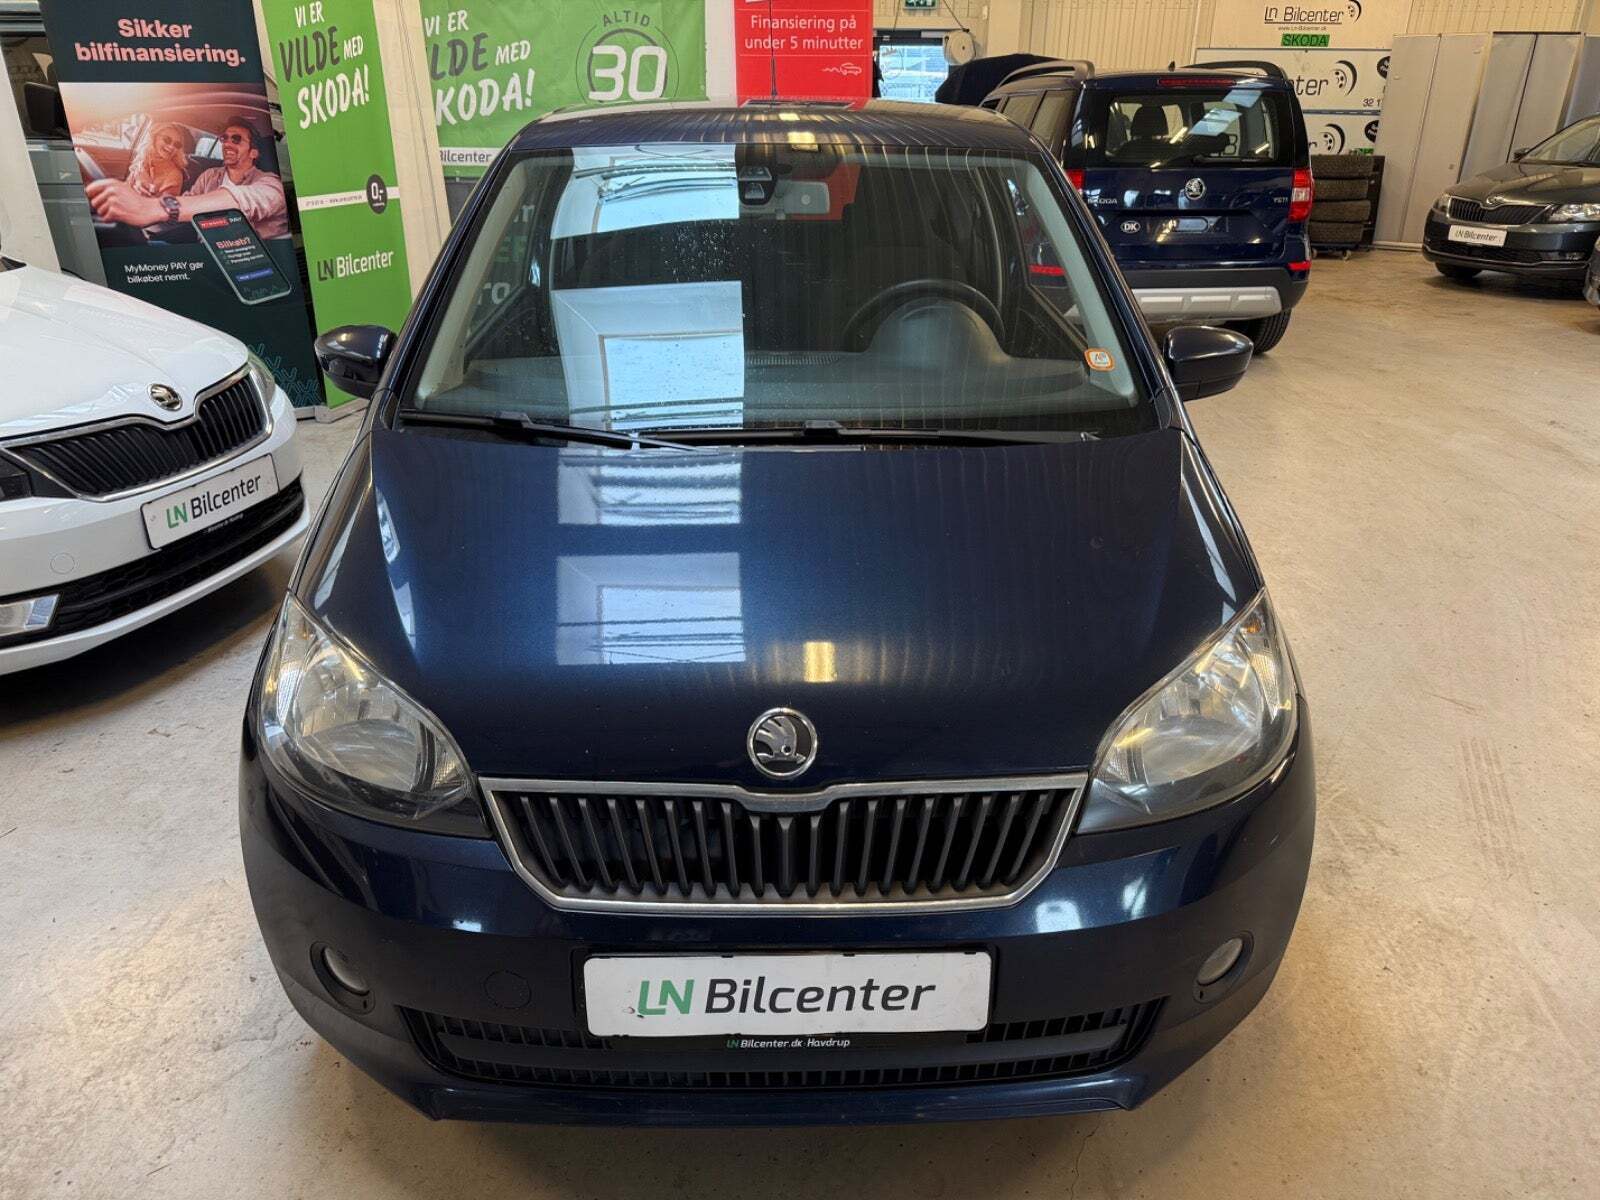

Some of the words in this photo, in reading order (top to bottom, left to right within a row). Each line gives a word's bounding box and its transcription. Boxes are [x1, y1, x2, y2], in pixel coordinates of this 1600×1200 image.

[294, 5, 307, 28] VI
[309, 1, 325, 24] ER
[424, 16, 440, 37] VI
[447, 10, 469, 32] ER
[602, 10, 651, 27] ALTID
[751, 15, 835, 32] Finansiering
[839, 14, 857, 32] på
[1283, 6, 1344, 22] Bilcenter
[117, 18, 192, 38] Sikker
[744, 35, 786, 49] under
[790, 36, 798, 49] 5
[802, 36, 864, 49] minutter
[1282, 34, 1329, 47] SKODA
[74, 42, 246, 67] bilfinansiering.
[279, 26, 340, 82] VILDE
[343, 35, 364, 60] MED
[430, 32, 489, 80] LDE
[495, 40, 531, 66] MED
[588, 45, 668, 100] 30
[297, 64, 370, 130] SKODA!
[435, 67, 536, 127] KODA!
[1292, 75, 1329, 96] ter
[1124, 223, 1138, 231] DK
[1464, 231, 1498, 241] Bilcenter
[124, 263, 169, 274] MyMoney
[170, 261, 187, 270] PAY
[336, 250, 394, 278] Bilcenter
[166, 502, 188, 529] LN
[190, 475, 261, 519] Bilcenter
[637, 979, 694, 1016] LN
[705, 976, 936, 1015] Bilcenter
[807, 1037, 850, 1048] Havdrup
